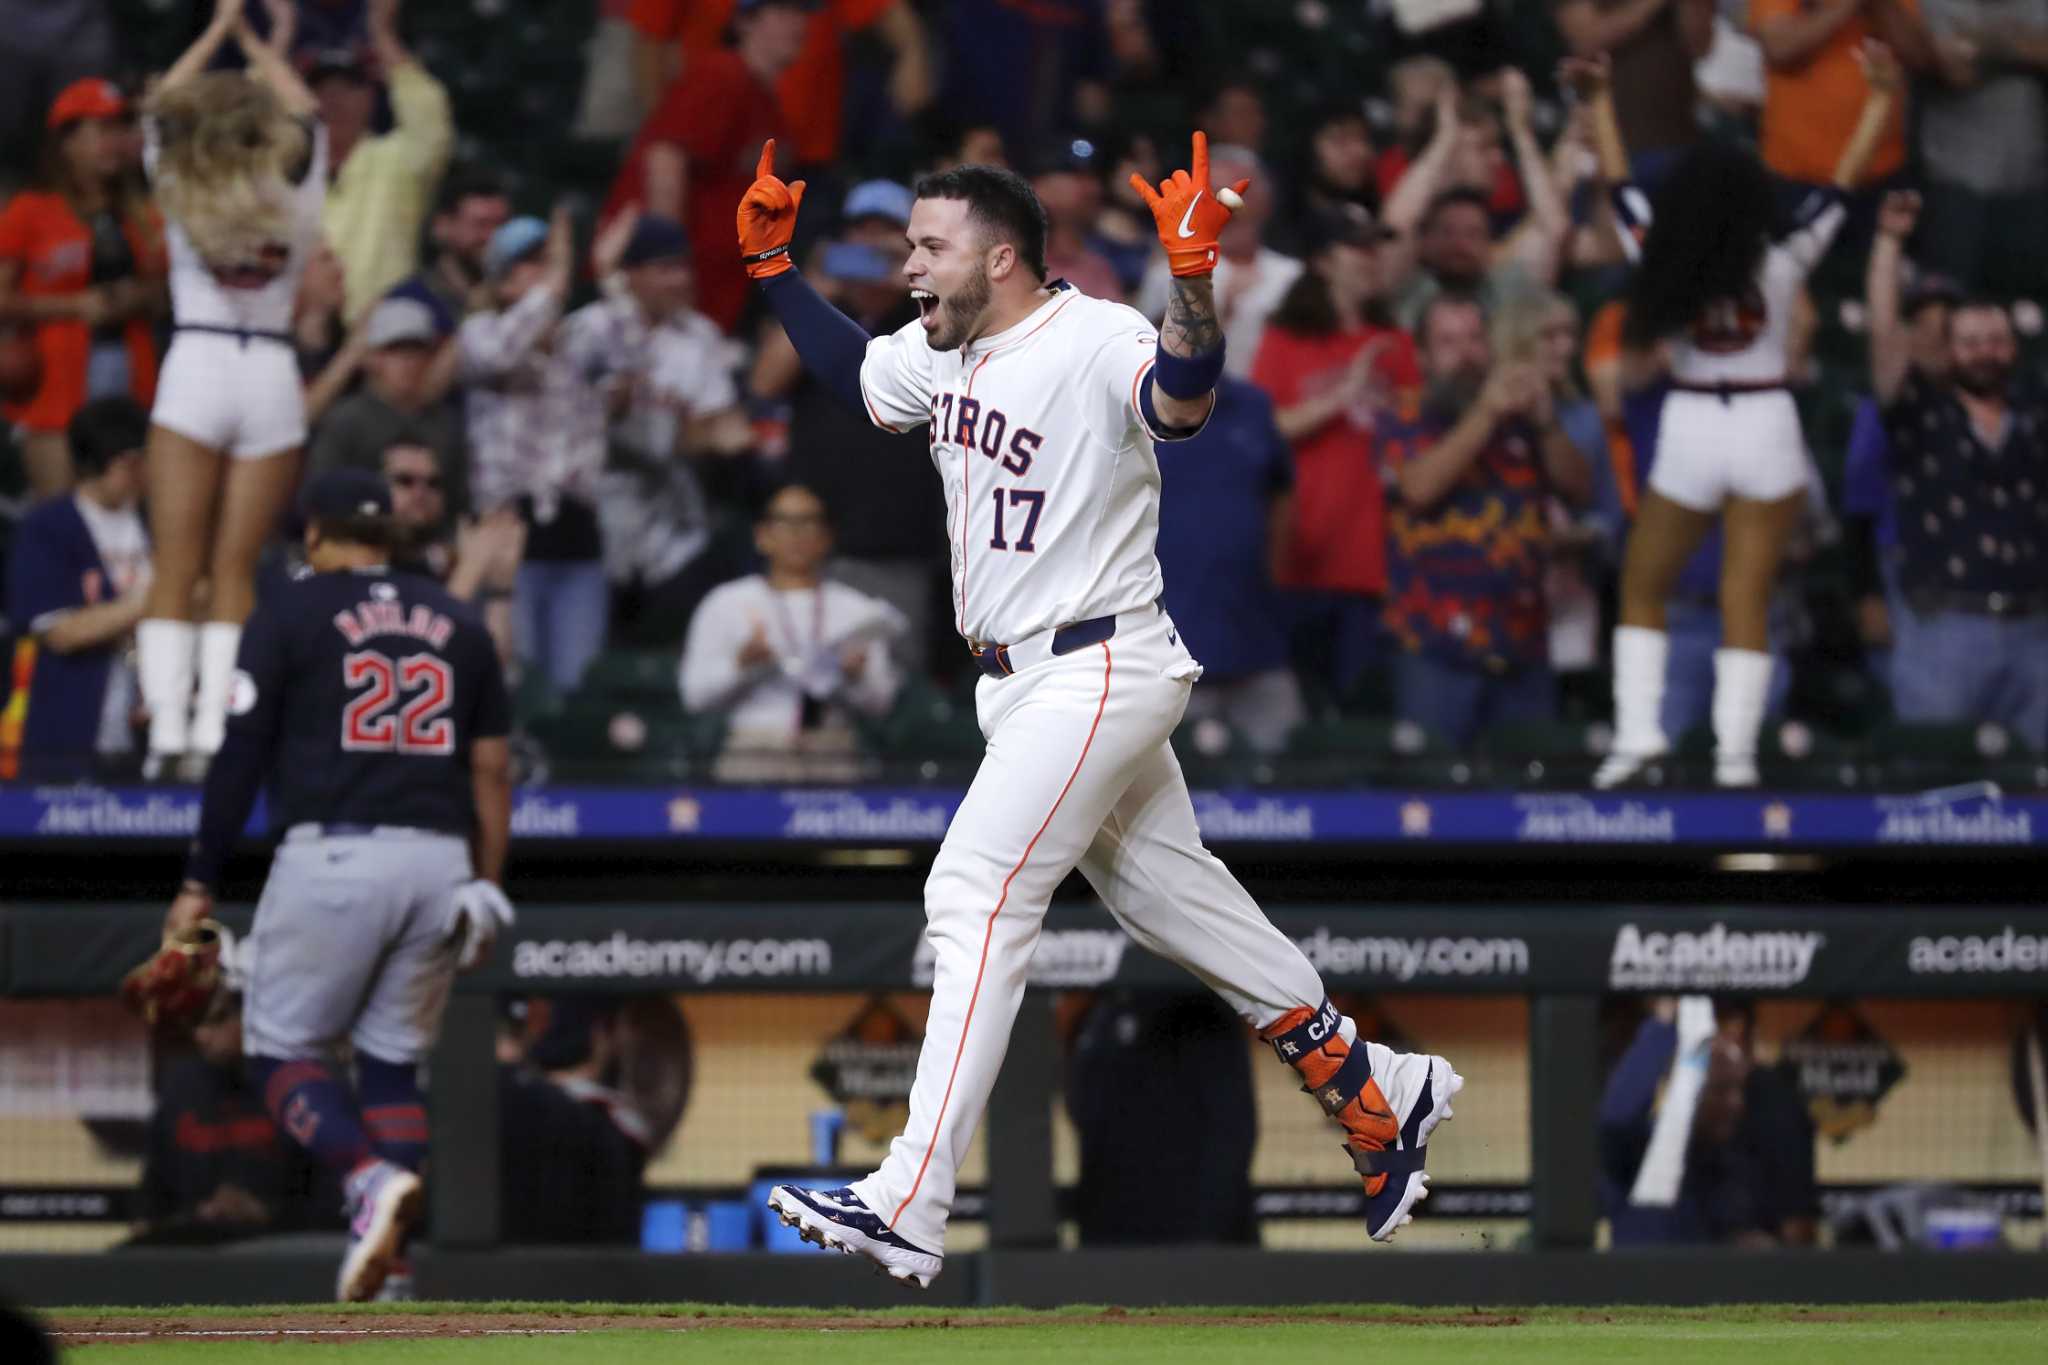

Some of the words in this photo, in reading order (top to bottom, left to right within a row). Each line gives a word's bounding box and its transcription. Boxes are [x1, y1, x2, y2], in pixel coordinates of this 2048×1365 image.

[930, 392, 1044, 477] STROS
[990, 487, 1046, 553] 17
[342, 651, 456, 756] 22
[1284, 927, 1529, 981] demy.com
[1609, 922, 1822, 983] Academy
[1908, 925, 2048, 973] acade
